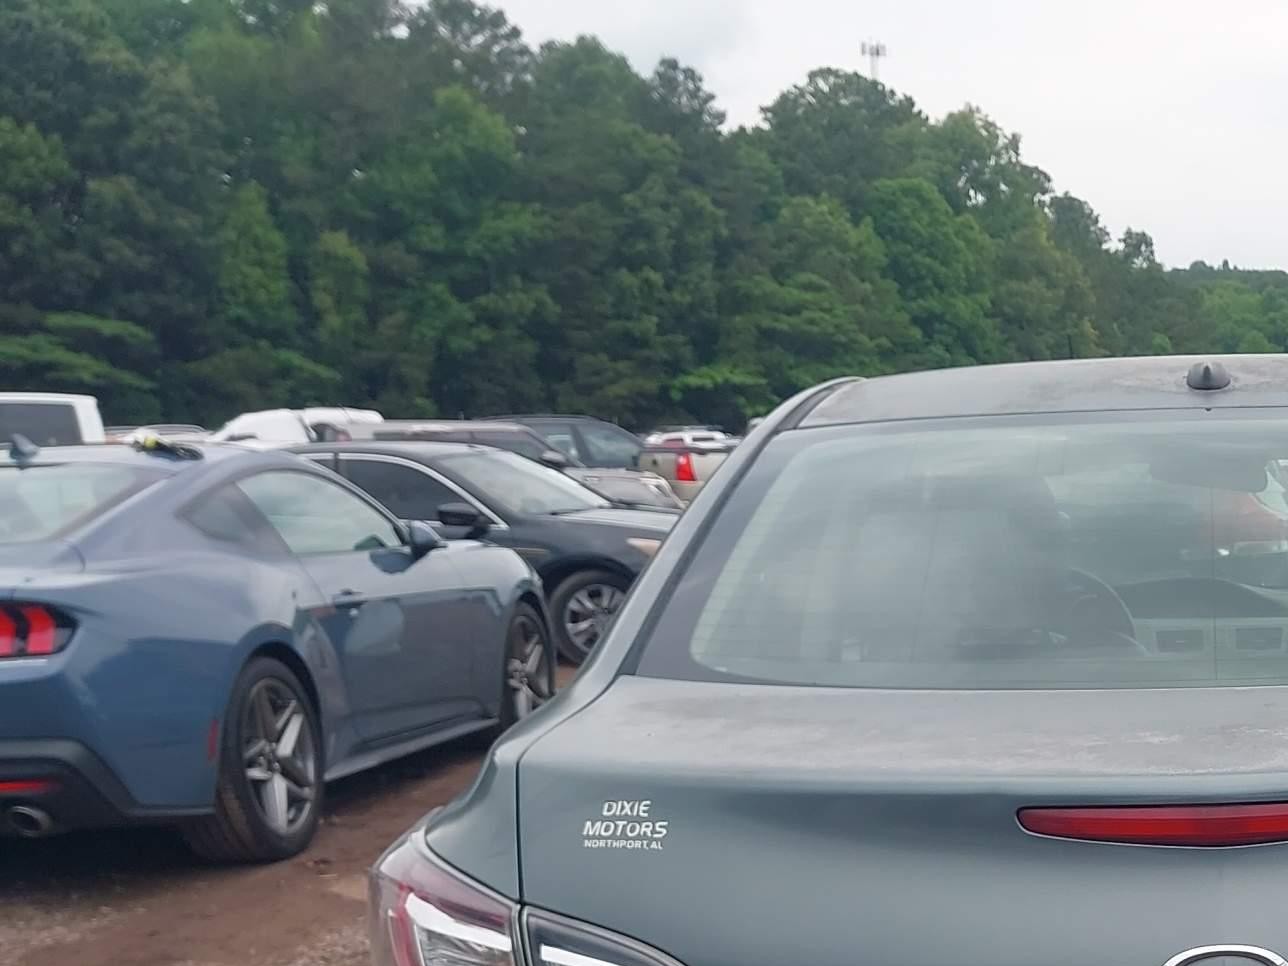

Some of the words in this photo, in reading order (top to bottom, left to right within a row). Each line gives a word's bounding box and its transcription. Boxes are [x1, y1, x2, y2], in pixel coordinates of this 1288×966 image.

[602, 800, 651, 817] DIXIE
[583, 820, 668, 837] MOTORS
[650, 841, 663, 849] AL
